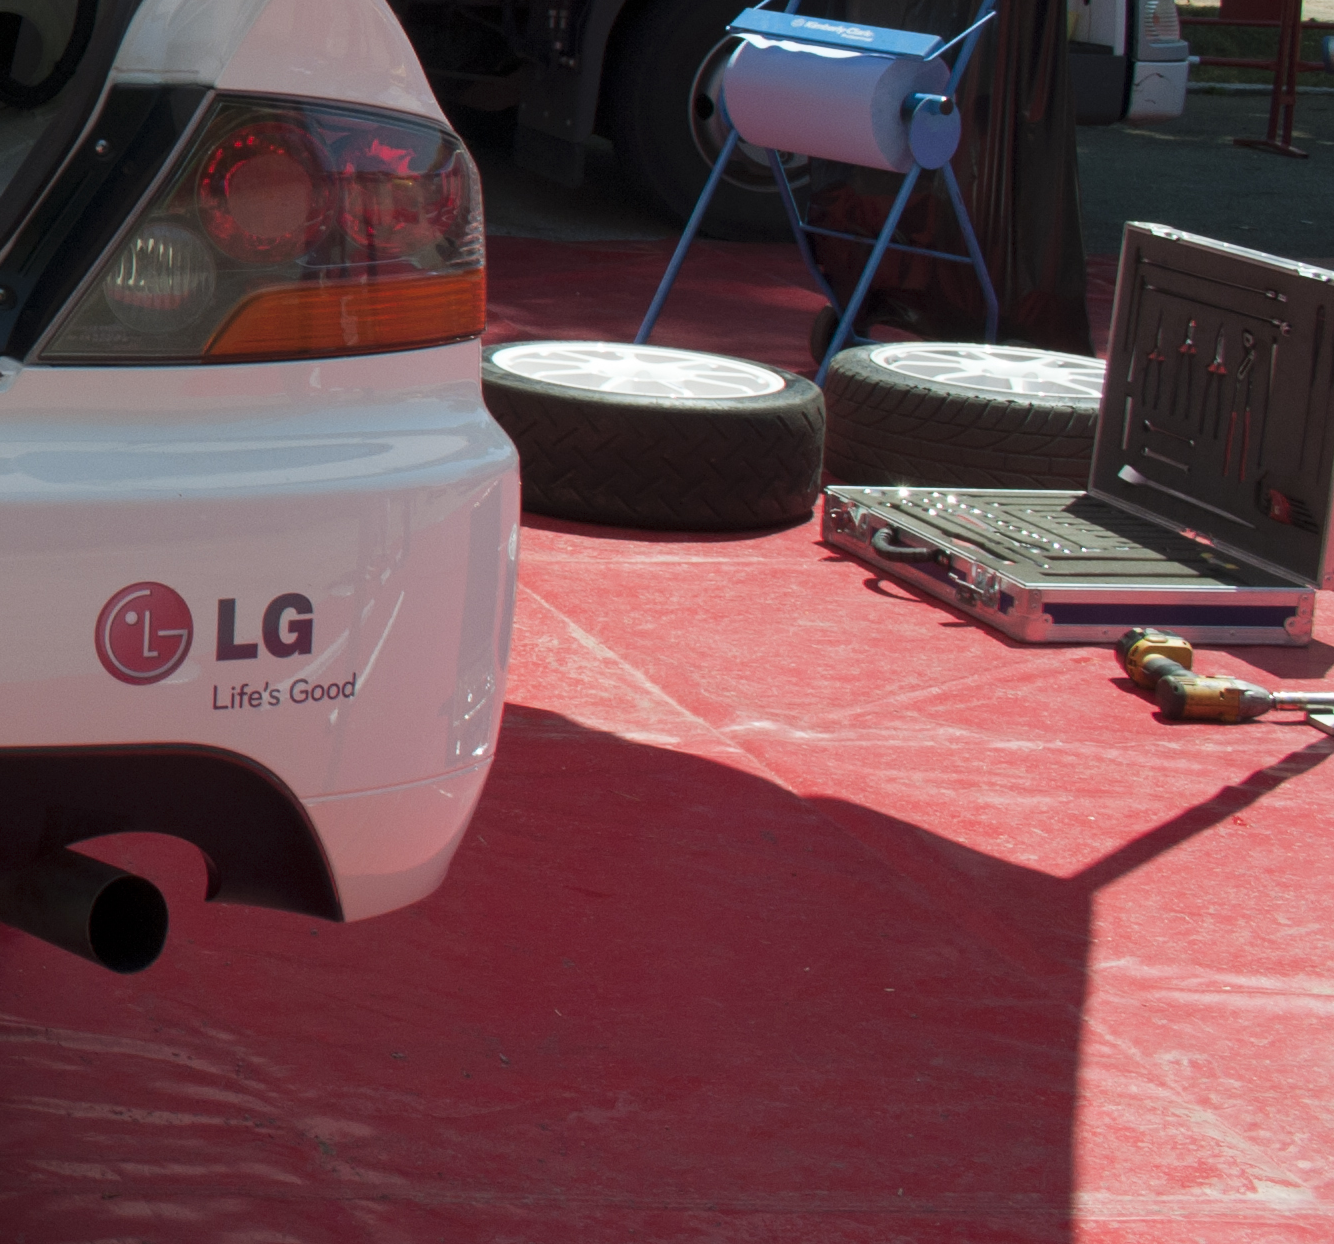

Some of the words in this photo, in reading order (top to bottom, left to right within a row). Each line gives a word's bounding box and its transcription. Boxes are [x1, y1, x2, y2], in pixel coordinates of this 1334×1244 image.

[216, 593, 314, 661] LG
[213, 682, 282, 711] Life's
[289, 672, 357, 704] Good
